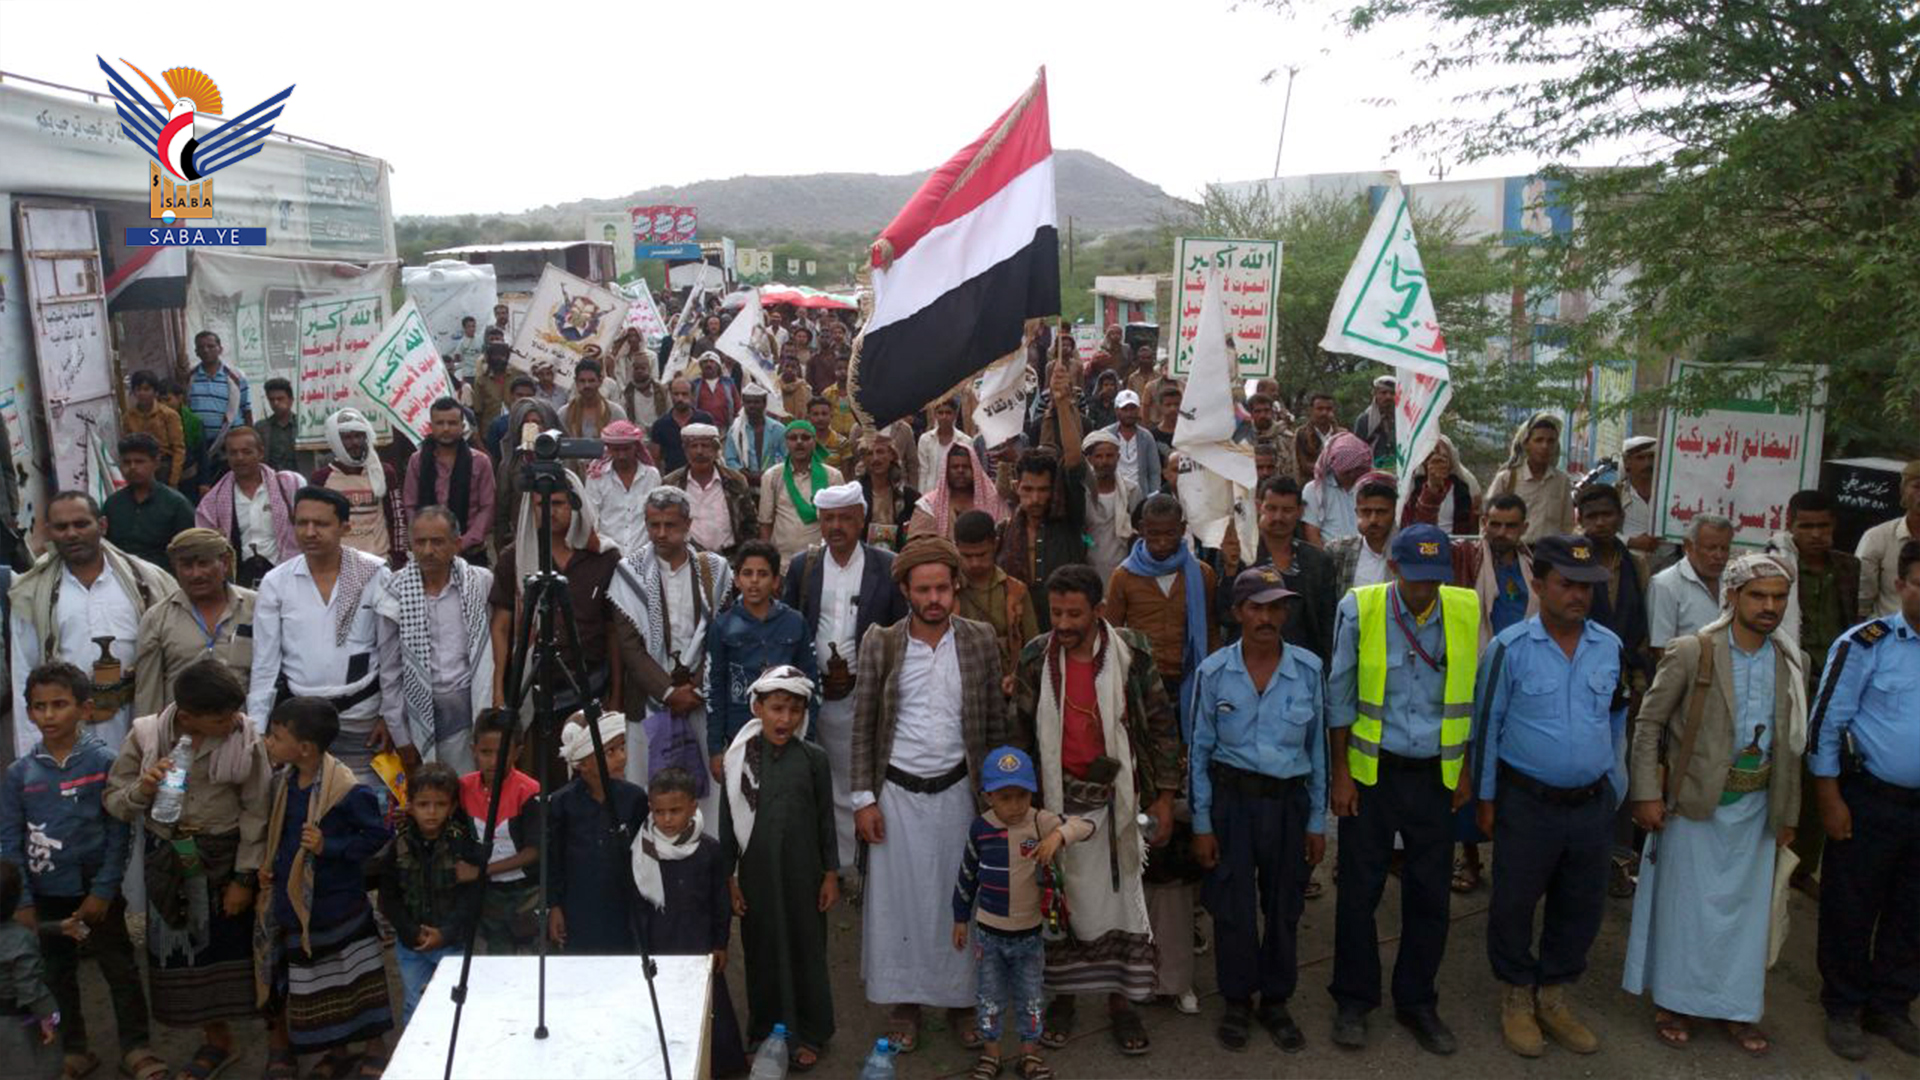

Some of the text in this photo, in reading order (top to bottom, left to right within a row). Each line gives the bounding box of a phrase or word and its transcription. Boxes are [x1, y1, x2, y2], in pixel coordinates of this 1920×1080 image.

[1185, 244, 1272, 274] الله أكبر
[1232, 279, 1270, 296] الموت
[1238, 345, 1265, 365] النص
